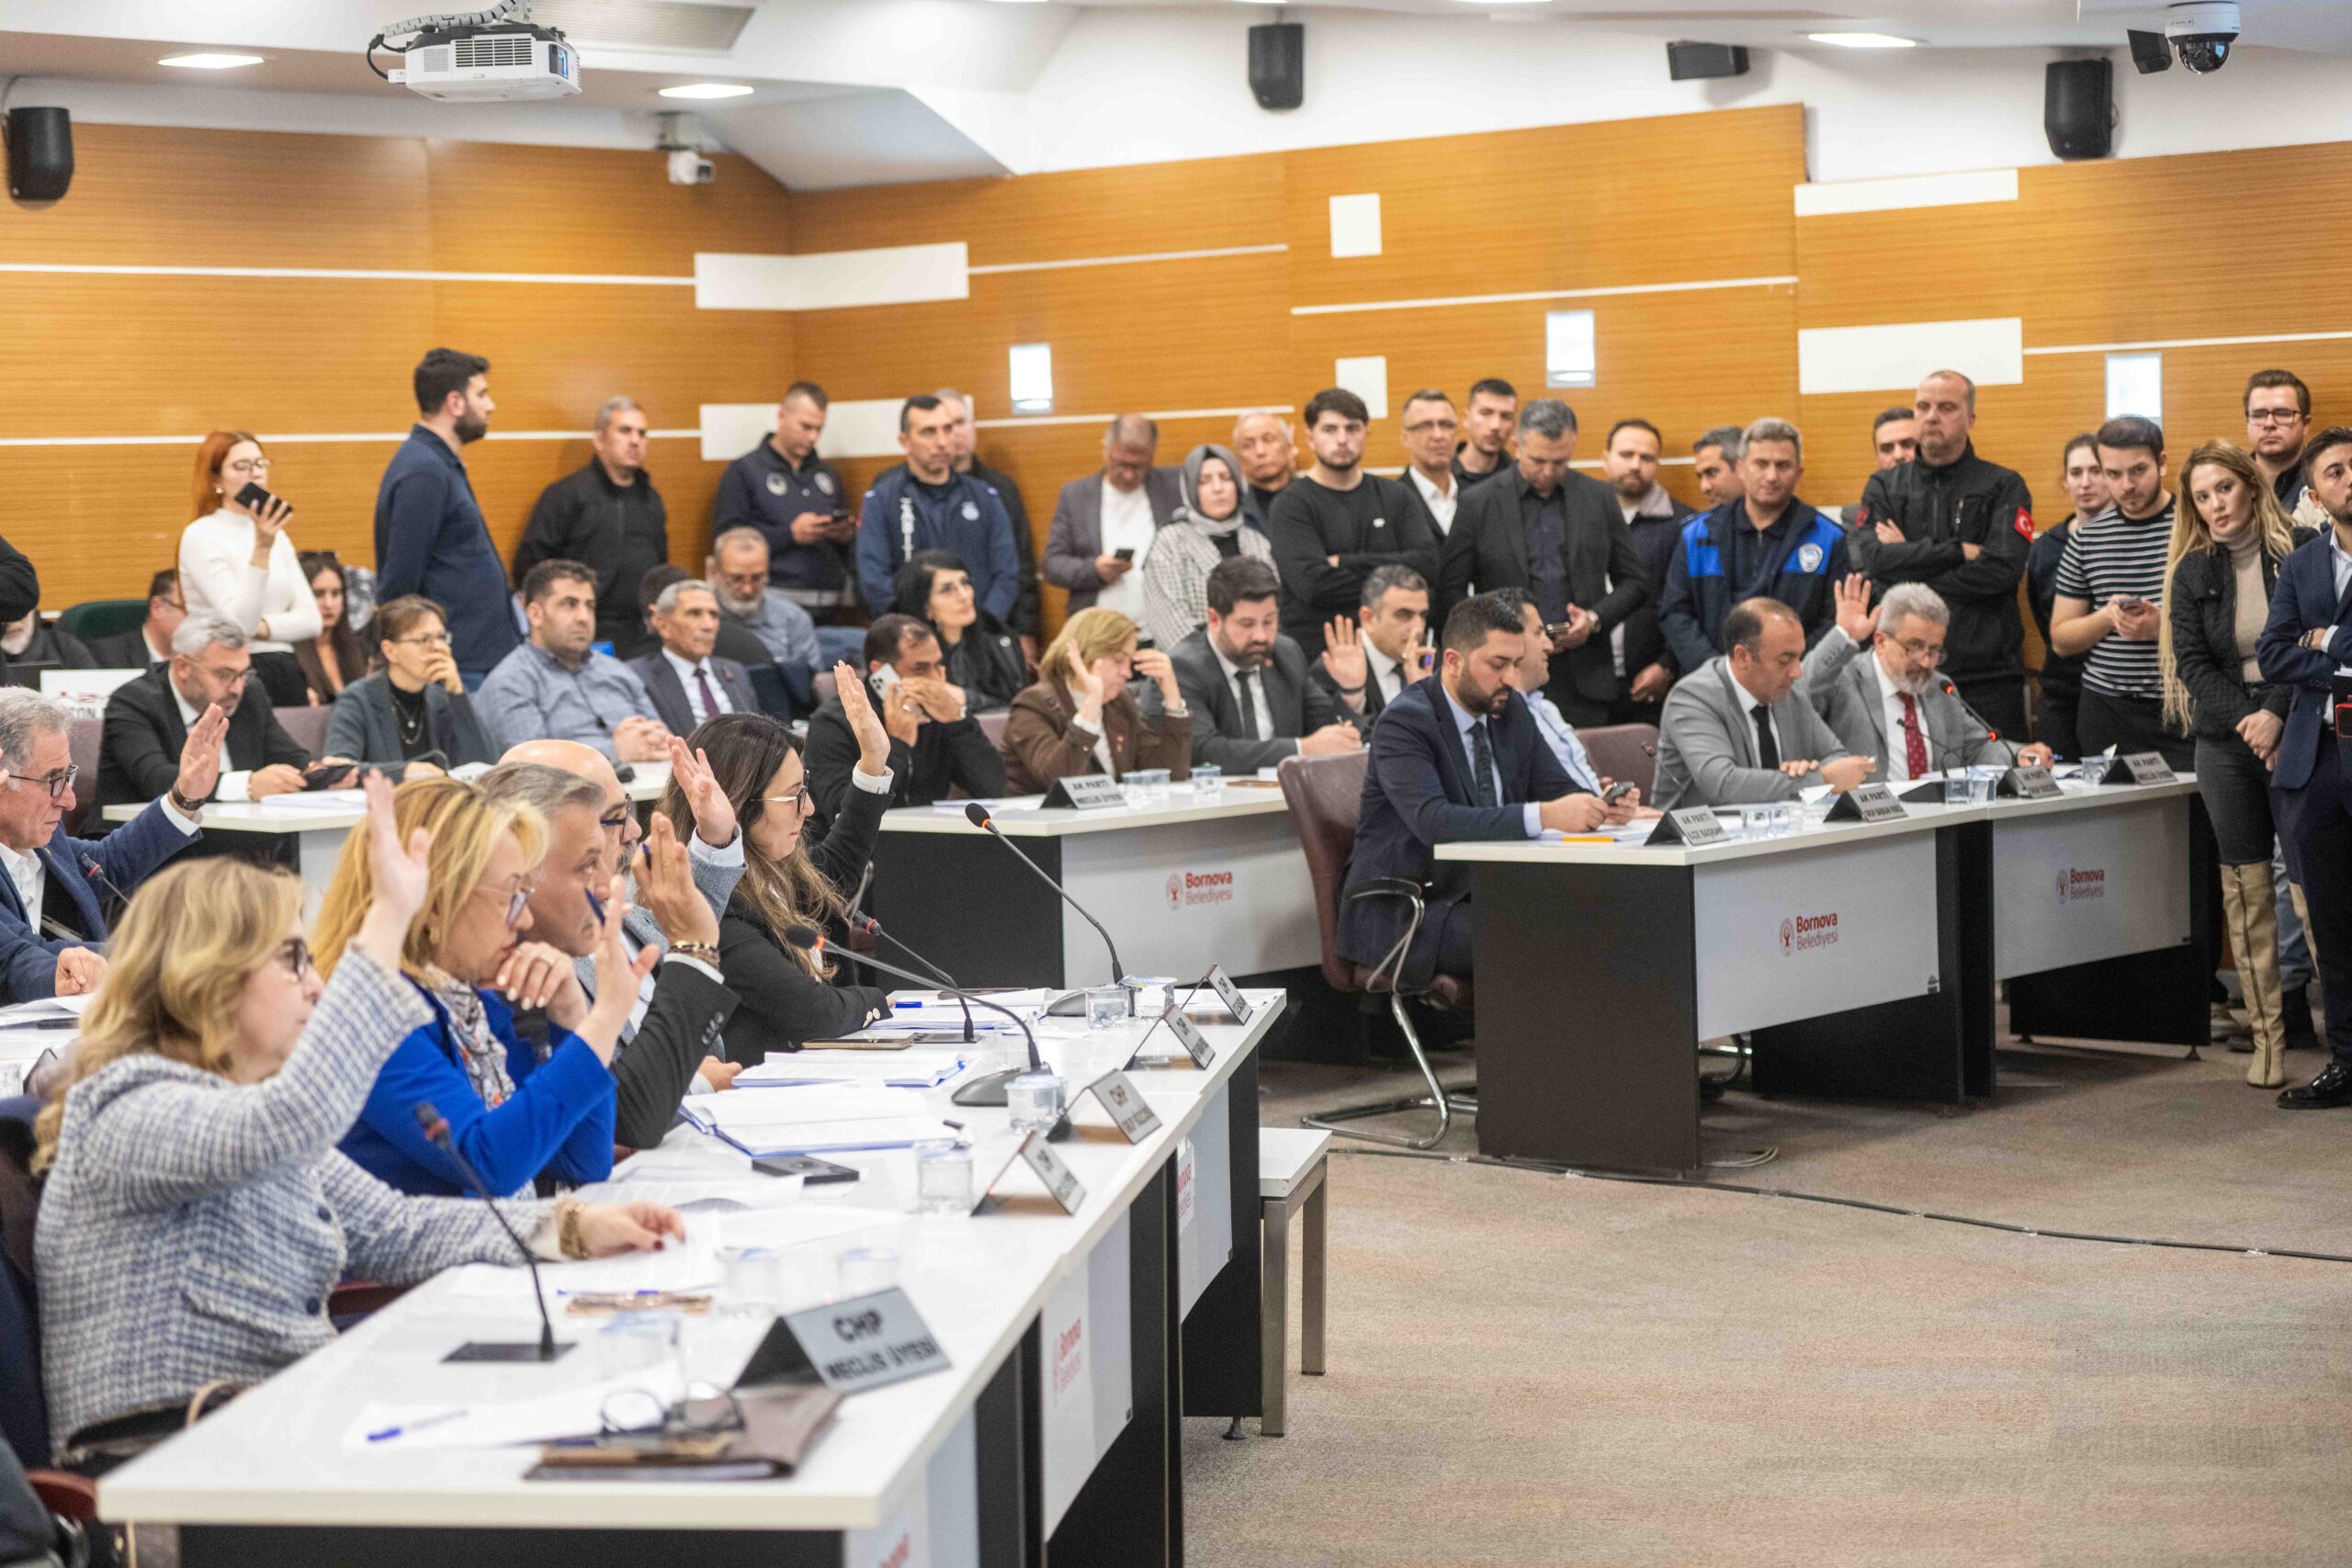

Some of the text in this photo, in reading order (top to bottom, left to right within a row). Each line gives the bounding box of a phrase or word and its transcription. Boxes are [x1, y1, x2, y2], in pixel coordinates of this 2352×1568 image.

[1186, 872, 1233, 888] Bornova
[2070, 868, 2105, 885] Bornova
[1796, 913, 1838, 933] Bornova
[1797, 930, 1838, 951] Belediyesi
[832, 1309, 884, 1343] CHP
